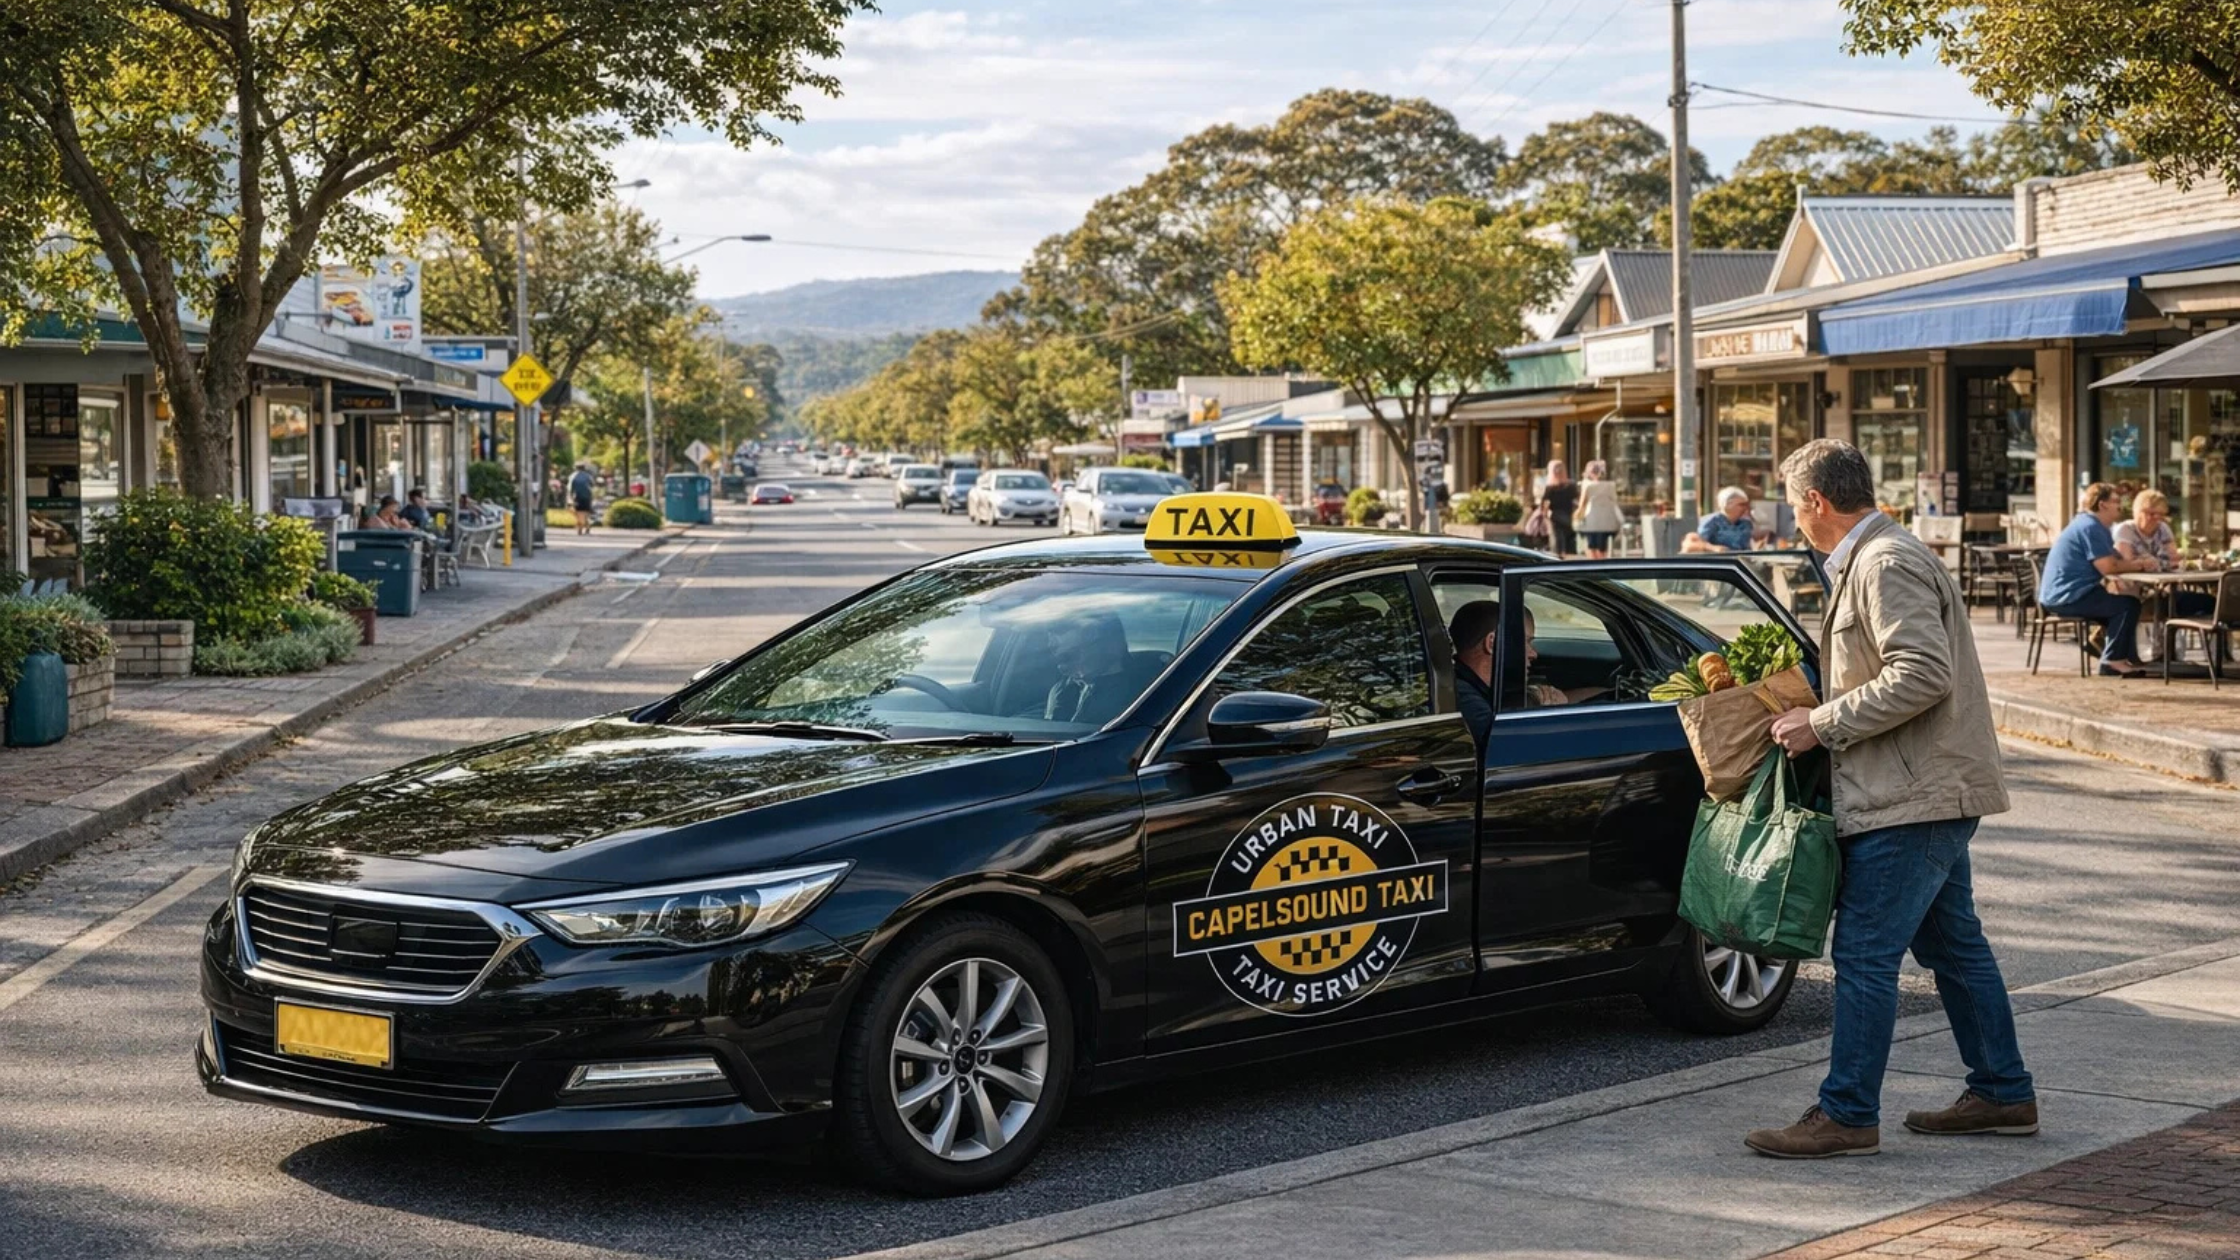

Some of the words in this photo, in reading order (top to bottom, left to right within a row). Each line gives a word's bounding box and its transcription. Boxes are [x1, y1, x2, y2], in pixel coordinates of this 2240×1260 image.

[1166, 508, 1255, 536] TAXI
[1232, 805, 1316, 875] URBAN
[1329, 805, 1389, 849] TAXI
[1189, 885, 1368, 940] CAPELSOUND
[1377, 874, 1435, 907] TAXI
[1231, 954, 1285, 1002] TAXI
[1293, 935, 1398, 1004] SERVICE
